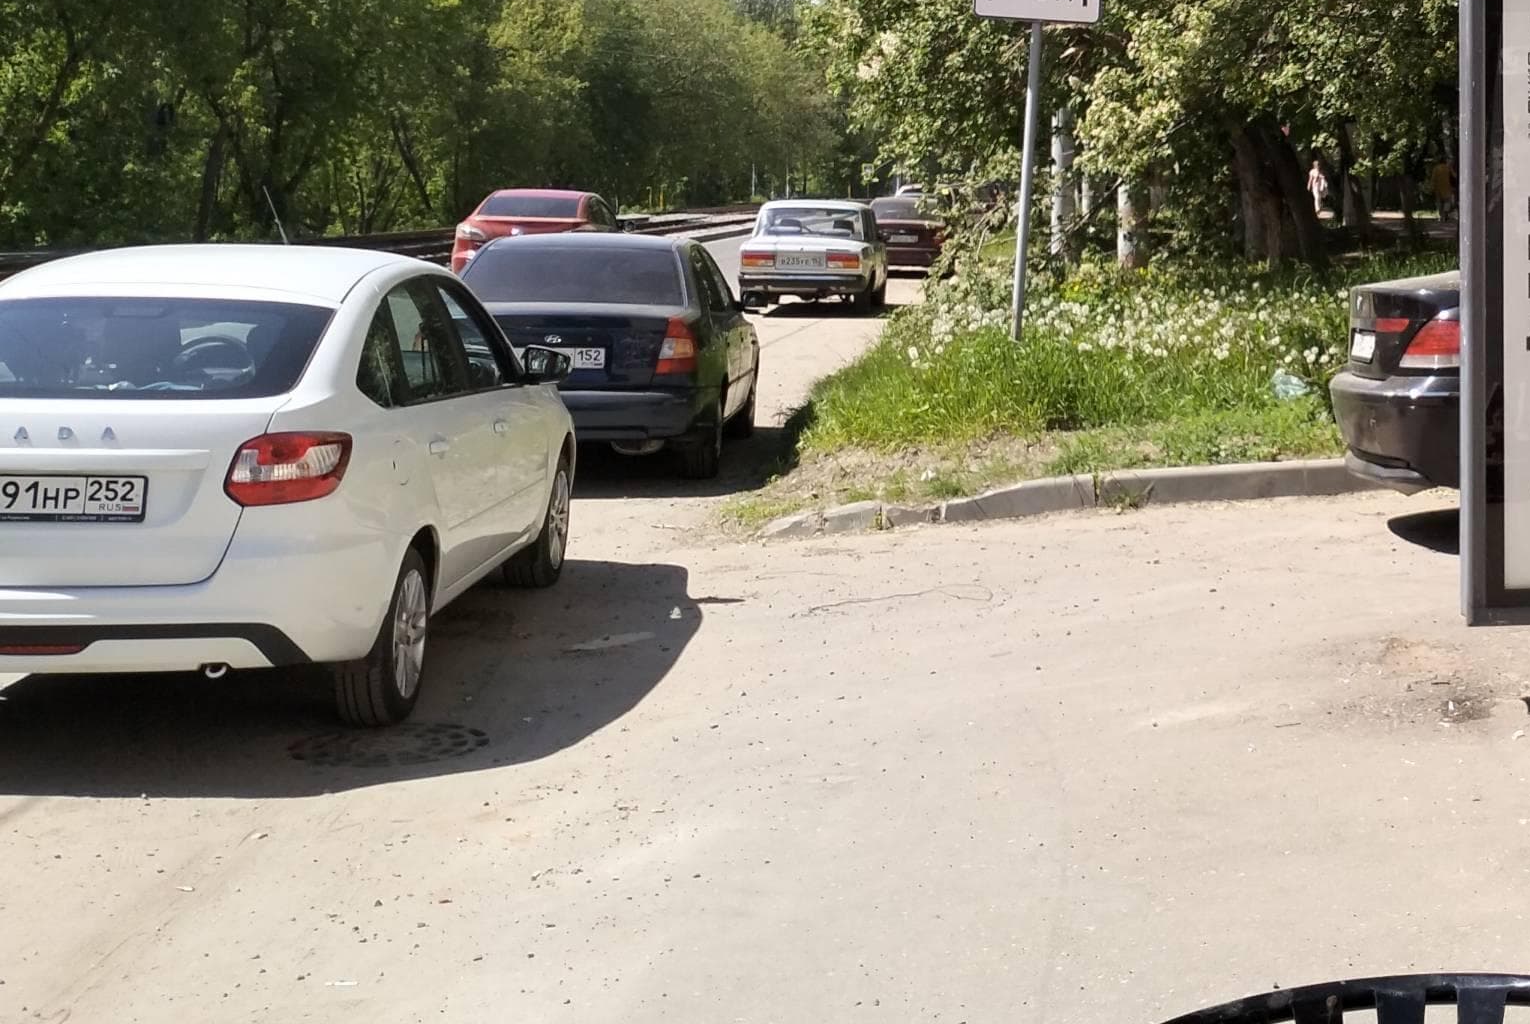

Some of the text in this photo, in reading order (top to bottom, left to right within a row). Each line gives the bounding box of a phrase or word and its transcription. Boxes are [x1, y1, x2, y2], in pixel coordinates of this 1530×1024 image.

[577, 349, 601, 362] 152
[88, 480, 135, 502] 252
[99, 503, 121, 512] RUS
